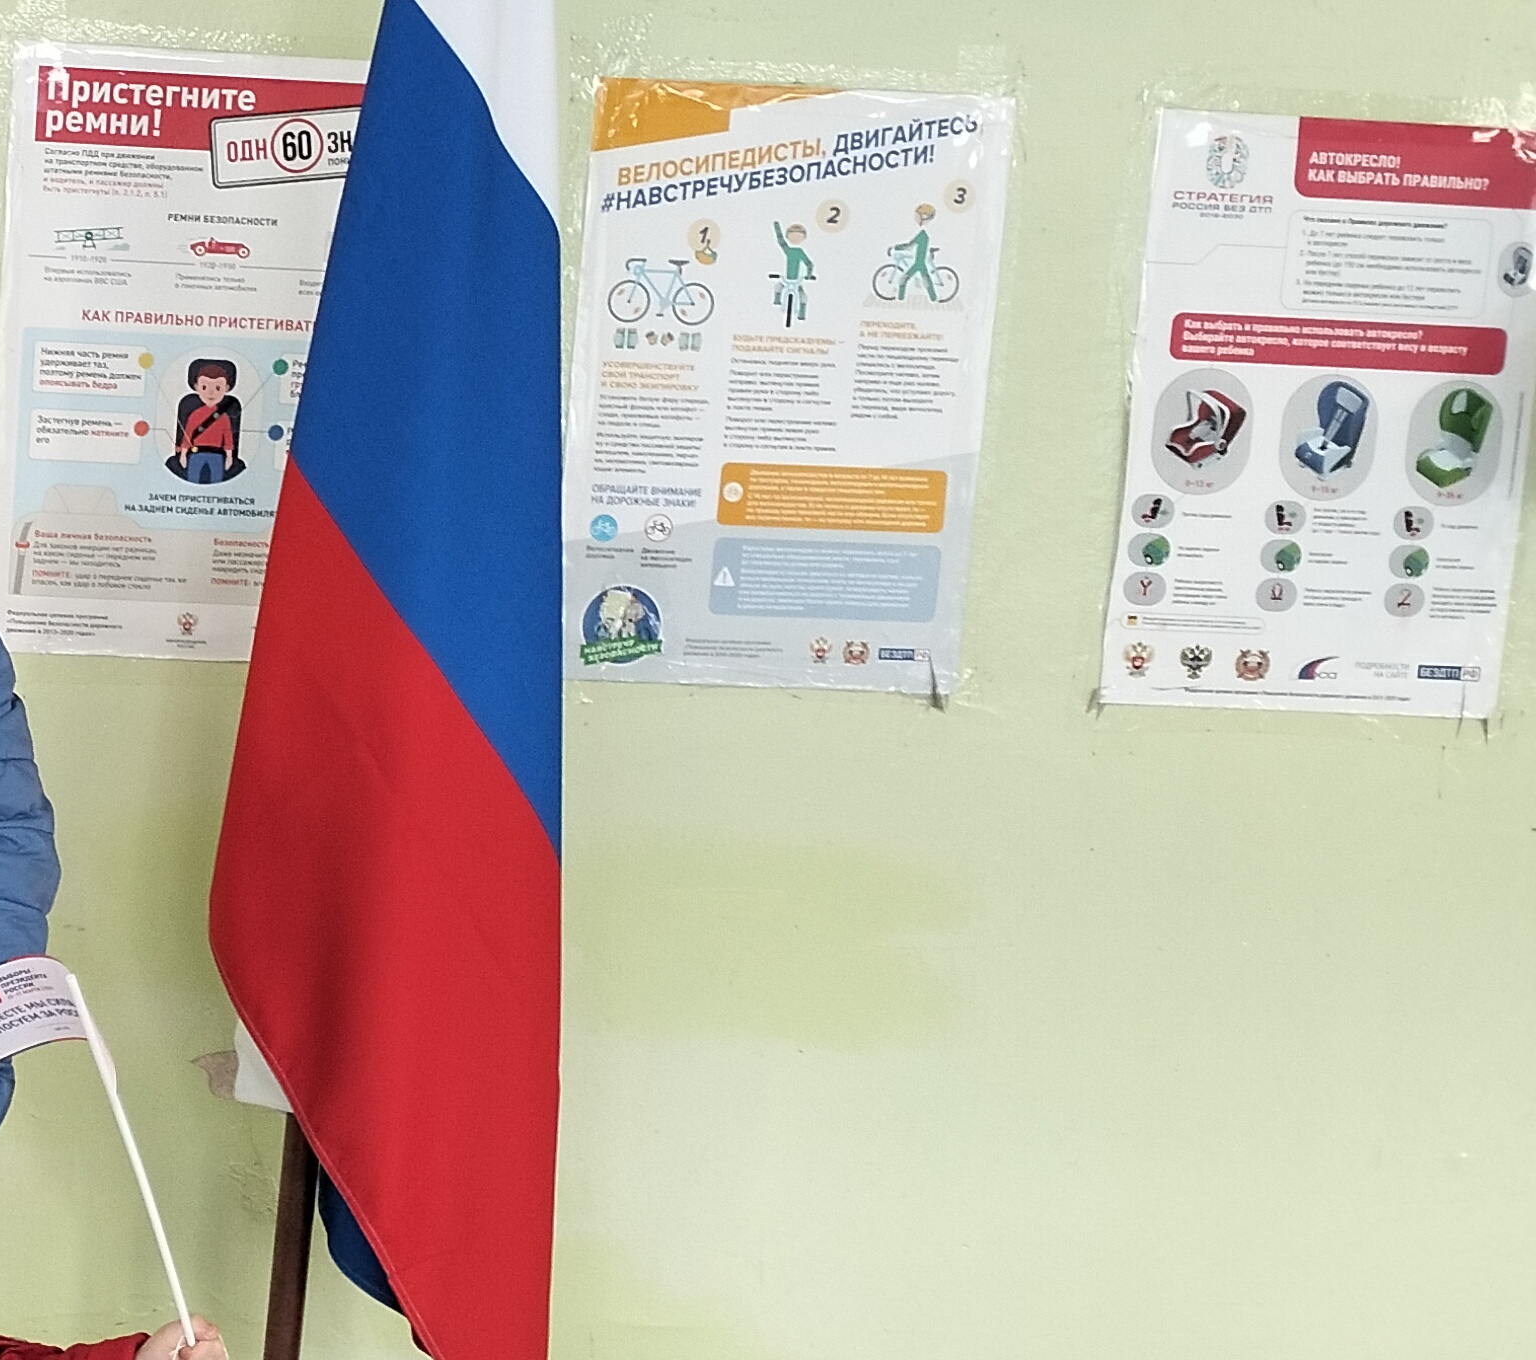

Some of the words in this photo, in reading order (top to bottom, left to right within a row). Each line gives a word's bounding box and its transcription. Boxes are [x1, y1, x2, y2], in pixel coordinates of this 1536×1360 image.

[46, 74, 256, 112] Пристегните
[45, 108, 162, 138] ремни!
[282, 130, 312, 161] 60
[327, 130, 352, 155] ЗН
[618, 138, 826, 186] ВЕЛОСИПЕДИСТЫ,
[1309, 151, 1401, 169] АВТОКРЕСЛО!
[601, 144, 935, 212] #НАВСТРЕЧУБЕЗОПАСНОСТИ!
[1308, 168, 1334, 182] КАК
[1337, 170, 1400, 186] ВЫБРАТЬ
[1403, 173, 1490, 190] ПРАВИЛЬНО?
[953, 187, 967, 205] 3
[1173, 190, 1274, 204] СТРАТЕГИЯ
[826, 207, 841, 224] 2
[1172, 202, 1220, 211] РОССИЯ
[1224, 204, 1246, 212] БЕЗ
[1249, 206, 1273, 214] ДТП
[167, 213, 201, 223] РЕМНИ
[203, 215, 278, 227] БЕЗОПАСНОСТИ
[699, 226, 709, 243] 1
[81, 309, 111, 322] КАК
[115, 311, 204, 327] ПРАВИЛЬНО
[209, 316, 314, 333] ПРИСТЕГИВАТ
[148, 493, 176, 501] ЗАЧЕМ
[179, 494, 255, 505] ПРИСТЕГИВАТЬСЯ
[139, 505, 173, 513] ЗАДНЕМ
[175, 506, 214, 515] СИДЕНЬЕ
[24, 999, 48, 1012] МЫ
[39, 1008, 55, 1020] ЗА
